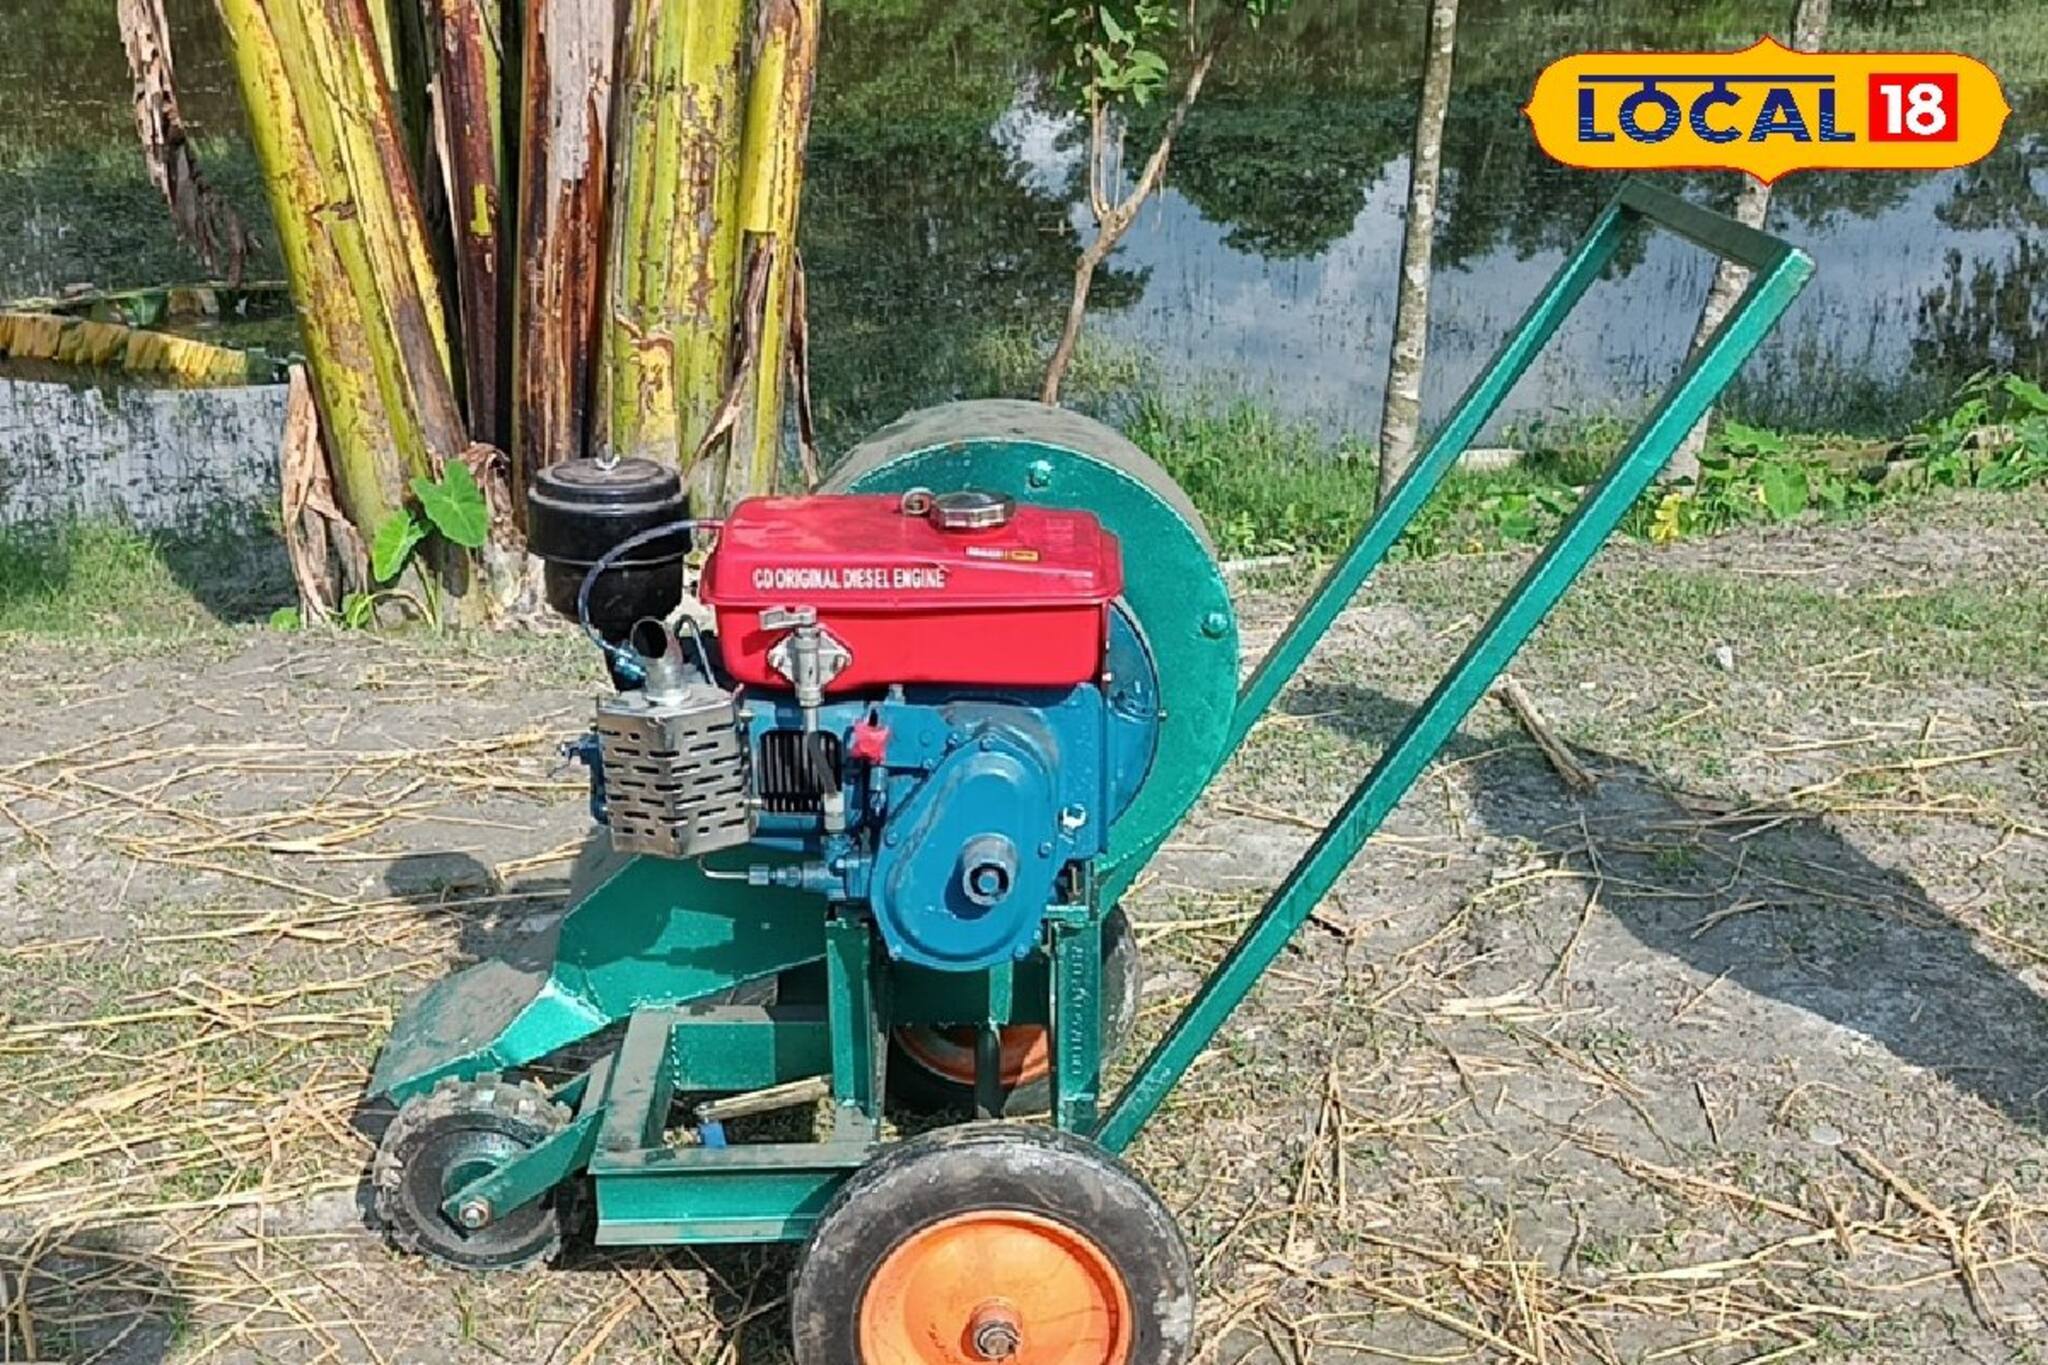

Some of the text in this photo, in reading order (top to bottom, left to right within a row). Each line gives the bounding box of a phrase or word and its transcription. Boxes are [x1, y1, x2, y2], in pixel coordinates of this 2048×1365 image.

[774, 567, 841, 590] ORIGINAL
[843, 567, 890, 590] DIESEL
[893, 567, 945, 589] ENGINE
